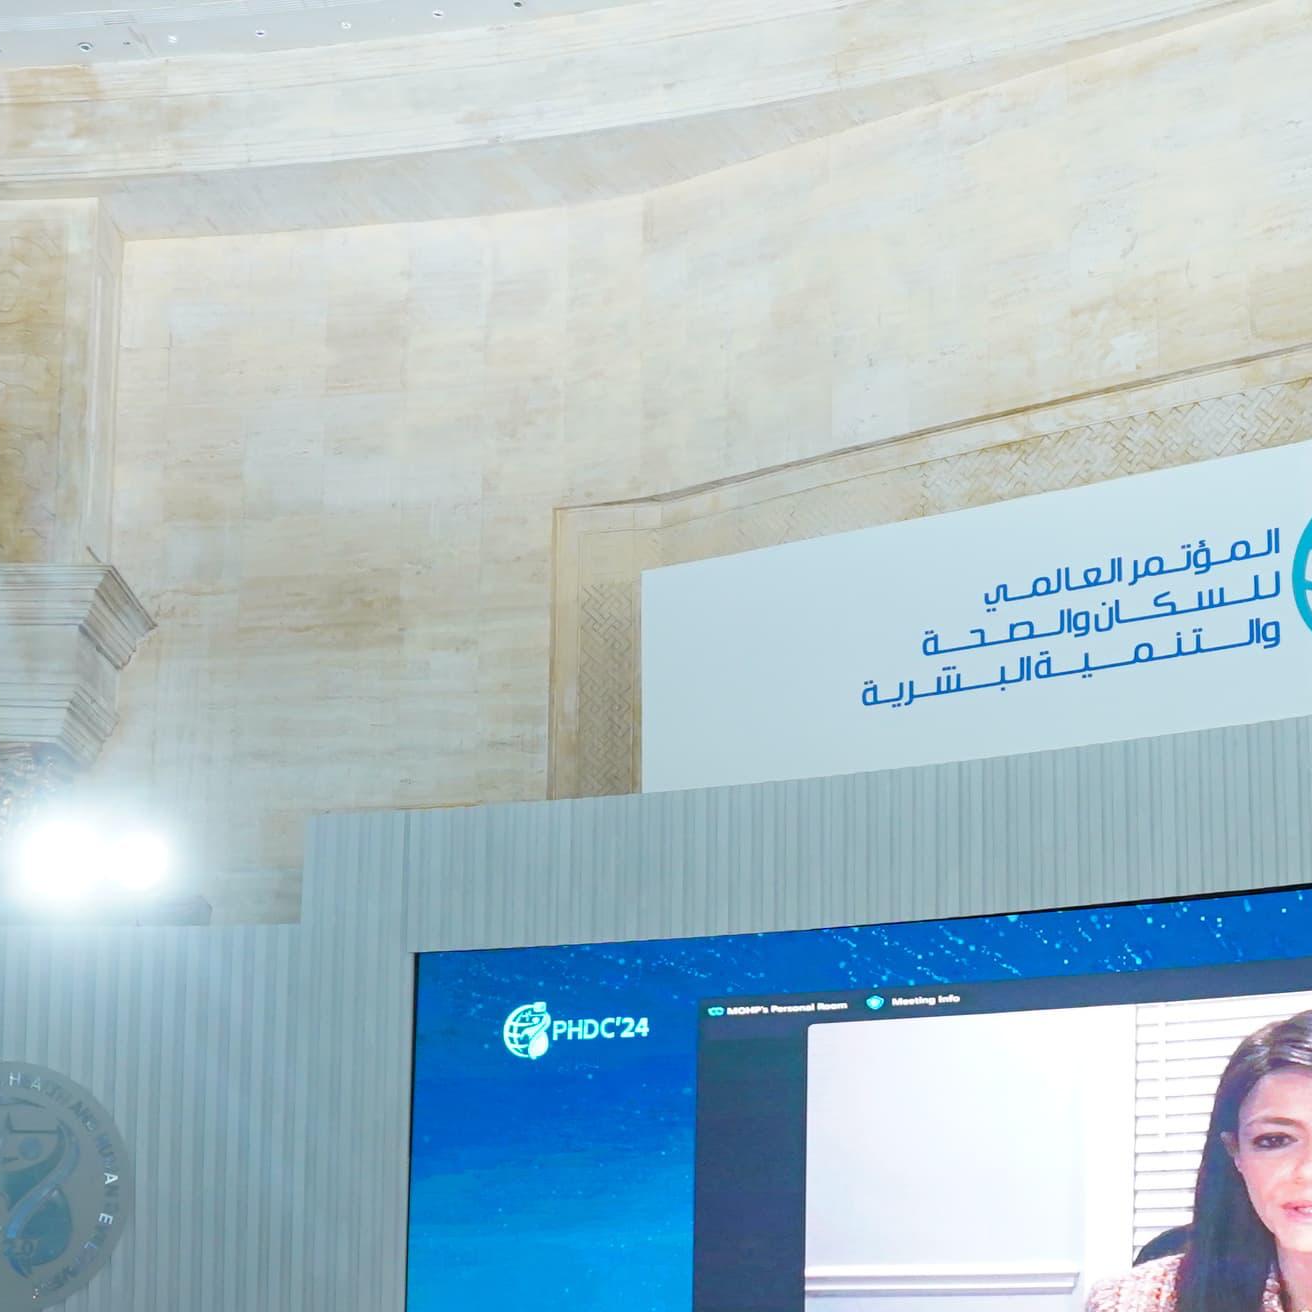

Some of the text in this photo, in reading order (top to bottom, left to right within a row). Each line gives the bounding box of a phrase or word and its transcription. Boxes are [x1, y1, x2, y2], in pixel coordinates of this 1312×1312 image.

[984, 527, 1281, 612] المؤتمر العالمي
[922, 570, 1281, 657] للسكان والصحة
[862, 617, 1281, 708] والتنمية البشرية
[771, 1003, 816, 1014] Personal
[817, 1001, 849, 1011] Room
[891, 994, 961, 1007] Meeting Info
[552, 1016, 650, 1041] PHDC'24
